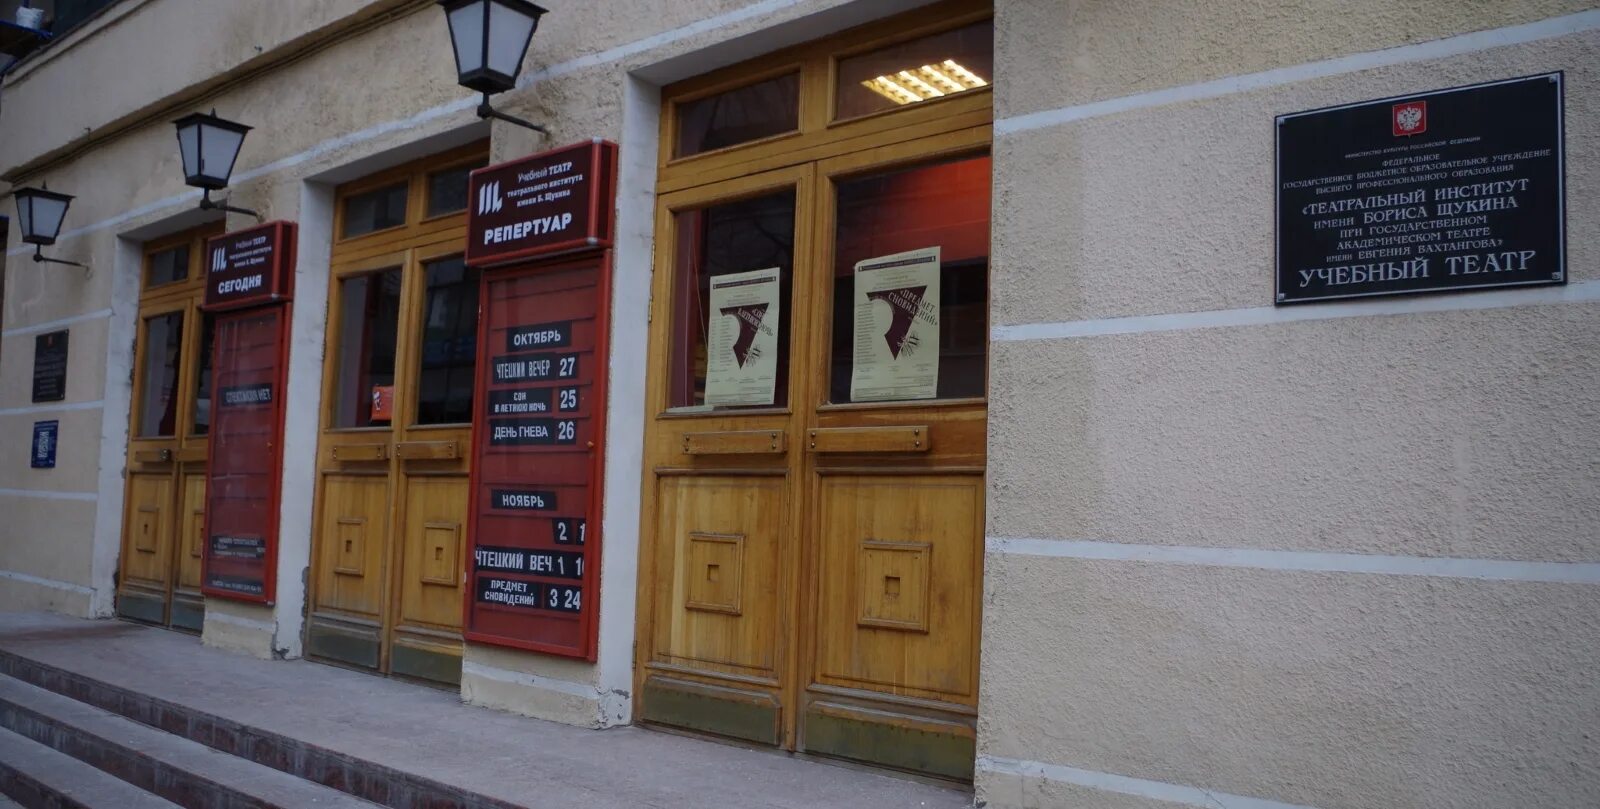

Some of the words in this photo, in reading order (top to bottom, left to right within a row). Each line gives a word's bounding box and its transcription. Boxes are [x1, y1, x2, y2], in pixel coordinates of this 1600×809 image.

[1283, 174, 1353, 189] ГОСУДАРСТВЕННОЕ
[1356, 167, 1406, 180] БЮДЖЕТНОЕ
[1410, 157, 1489, 173] ОБРАЗОВАТЕЛЬНОЕ
[1491, 148, 1551, 164] УЧРЕЖДЕНИЕ
[1382, 153, 1440, 167] ФЕДЕРАЛЬНОЕ
[518, 168, 548, 183] Учебный
[549, 161, 573, 175] ТЕАТР
[1316, 184, 1352, 195] ВЫСШЕГО
[1356, 172, 1447, 190] ПРОФЕССИОНАЛЬНОГО
[1452, 164, 1514, 179] ОБРАЗОВАНИЯ
[507, 184, 548, 198] театрального
[549, 174, 583, 186] института
[517, 198, 536, 207] имени
[545, 190, 570, 202] Щукина
[1302, 189, 1426, 216] «ТЕАТРАЛЬНЫЙ
[1435, 178, 1530, 201] ИНСТИТУТ
[1314, 216, 1354, 230] ИМЕНИ
[1364, 208, 1427, 225] БОРИСА
[1437, 197, 1518, 217] ЩУКИНА
[484, 212, 573, 245] РЕПЕРТУАР
[1340, 226, 1363, 239] ПРИ
[1369, 215, 1487, 236] ГОСУДАРСТВЕННОМ
[1337, 232, 1441, 251] АКАДЕМИЧЕСКОМ
[1447, 227, 1491, 240] ТЕАТРЕ
[1326, 252, 1353, 263] ИМЕНИ
[1358, 245, 1411, 260] ЕВГЕНИЯ
[1418, 239, 1503, 255] ВАХТАНГОВА»
[1299, 257, 1429, 288] УЧЕБНЫЙ
[1445, 250, 1537, 275] ТЕАТР
[218, 274, 262, 294] СЕГОДНЯ
[513, 330, 561, 346] ОКТЯБРЬ
[528, 359, 551, 377] ВЕЧЕР
[559, 357, 575, 377] 27
[513, 392, 526, 401] СОН
[560, 389, 576, 409] 25
[494, 404, 500, 413] В
[500, 403, 528, 412] ЛЕТНЮЮ
[529, 402, 546, 412] НОЧЬ
[494, 426, 517, 439] ДЕНЬ
[519, 425, 548, 438] ГНЕВА
[558, 421, 575, 440] 26
[502, 494, 545, 508] НОЯБРЬ
[558, 522, 568, 541] 2
[475, 550, 524, 569] ЧТЕЦКИЙ
[558, 556, 564, 575] 1
[490, 580, 528, 593] ПРЕДМЕТ
[484, 591, 535, 606] СНОВИДЕНИЙ
[549, 588, 558, 607] 3
[564, 589, 581, 610] 24
